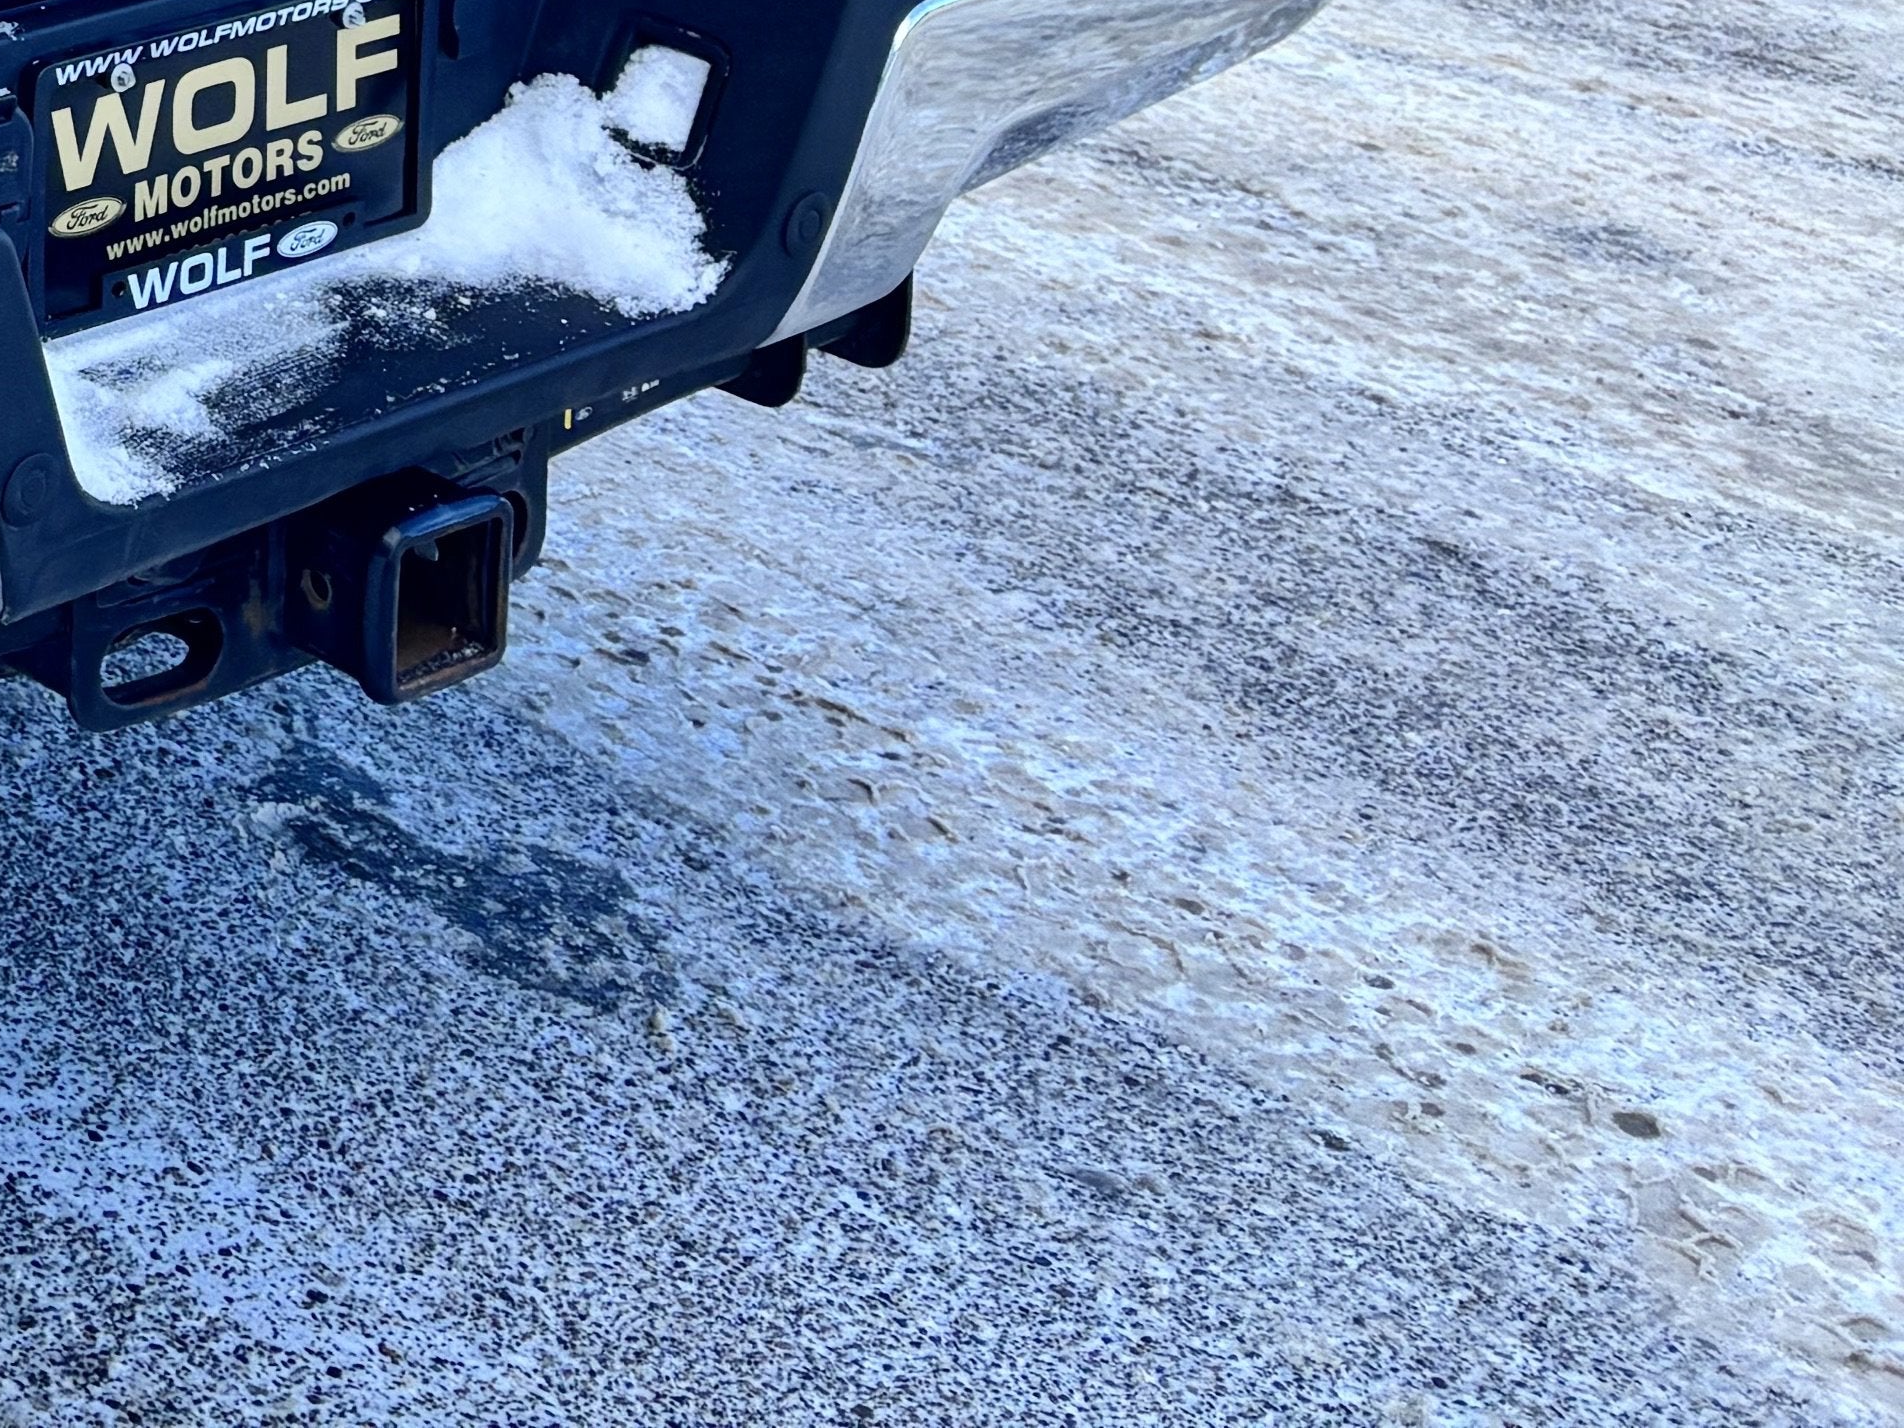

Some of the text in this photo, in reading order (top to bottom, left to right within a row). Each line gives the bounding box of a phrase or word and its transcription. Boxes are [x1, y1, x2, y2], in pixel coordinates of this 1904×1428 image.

[51, 14, 400, 192] WOLF
[348, 121, 388, 147] Ford
[134, 131, 323, 221] MOTORS
[66, 202, 109, 229] Ford
[107, 172, 351, 261] www.wolfmotors.com
[289, 228, 328, 254] Ford
[127, 234, 270, 309] WOLF
